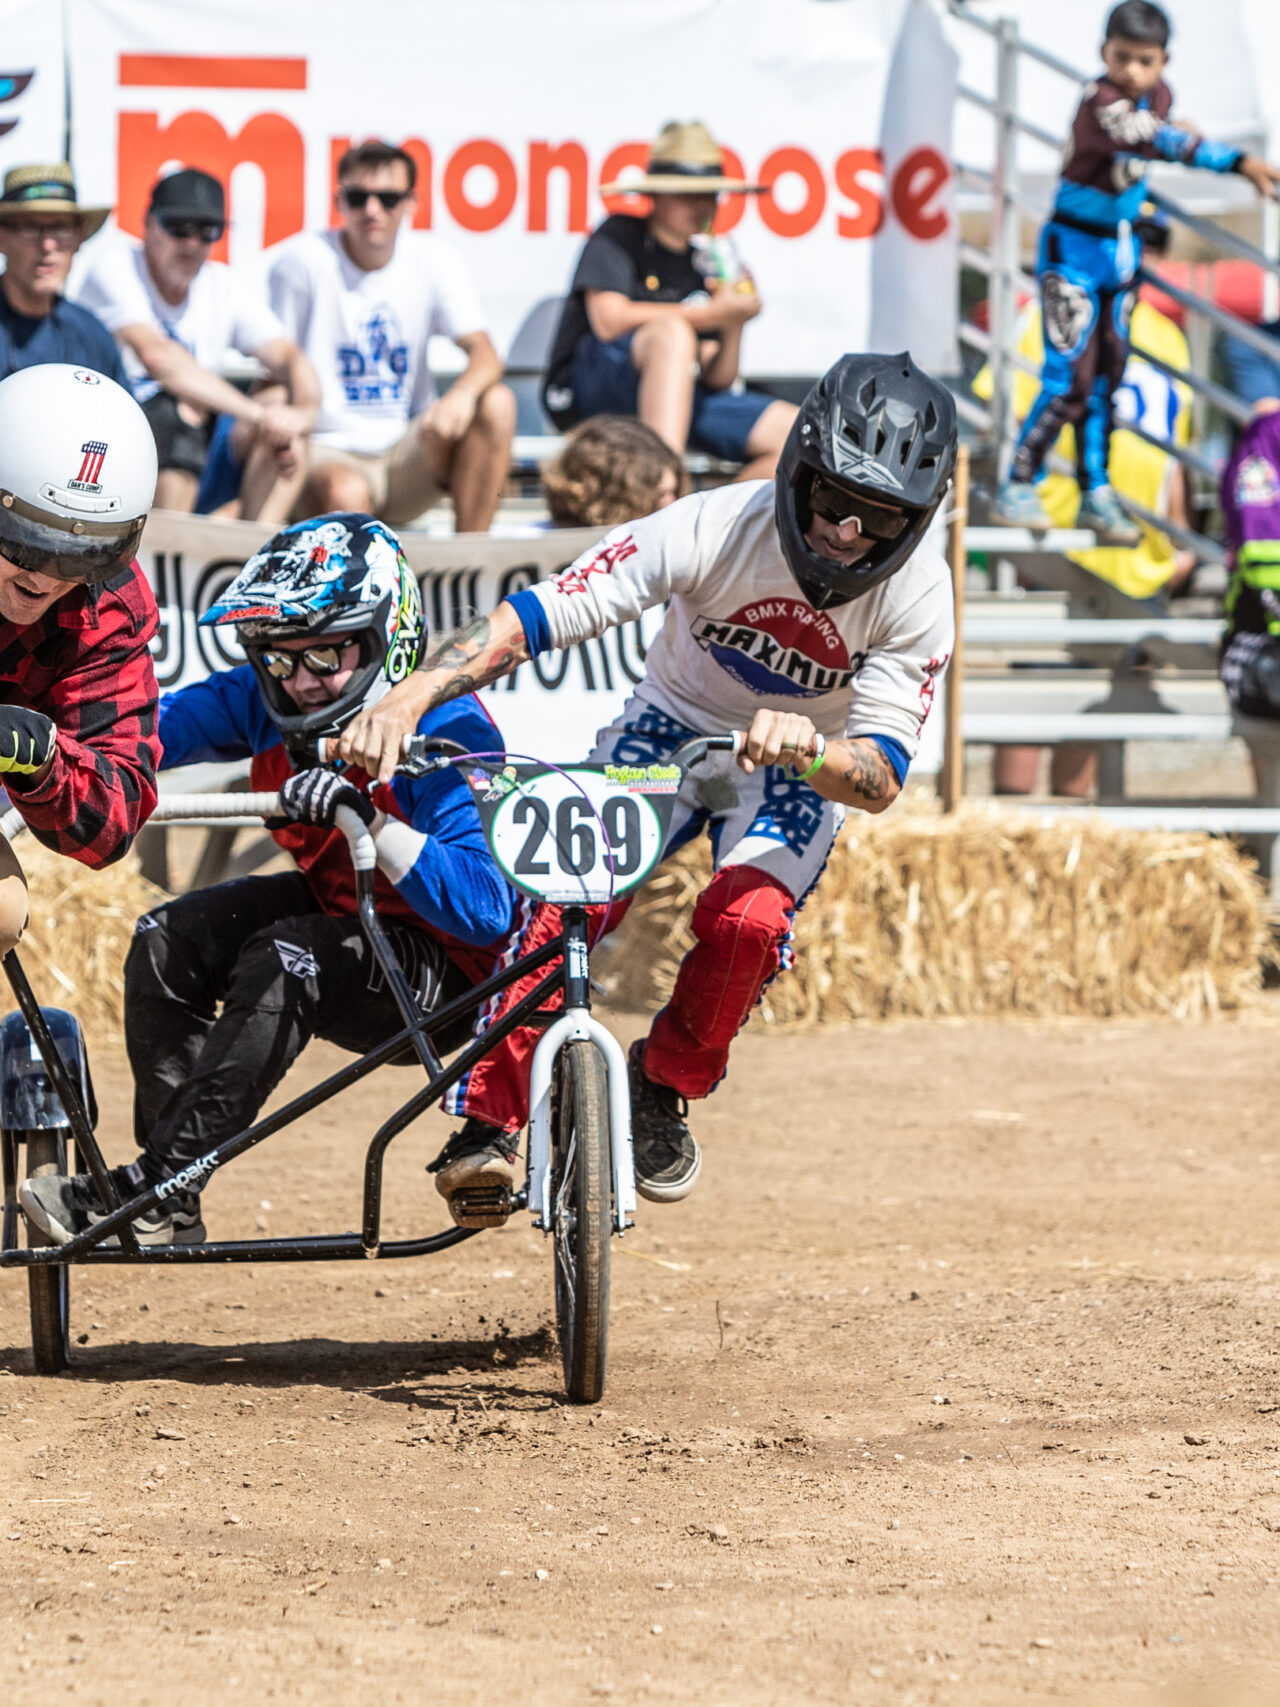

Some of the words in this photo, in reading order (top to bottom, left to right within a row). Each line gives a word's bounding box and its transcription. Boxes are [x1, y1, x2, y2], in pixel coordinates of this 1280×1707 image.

[744, 602, 788, 623] BMX
[792, 605, 839, 651] RAING
[512, 796, 642, 876] 269
[154, 1150, 219, 1200] impakt
